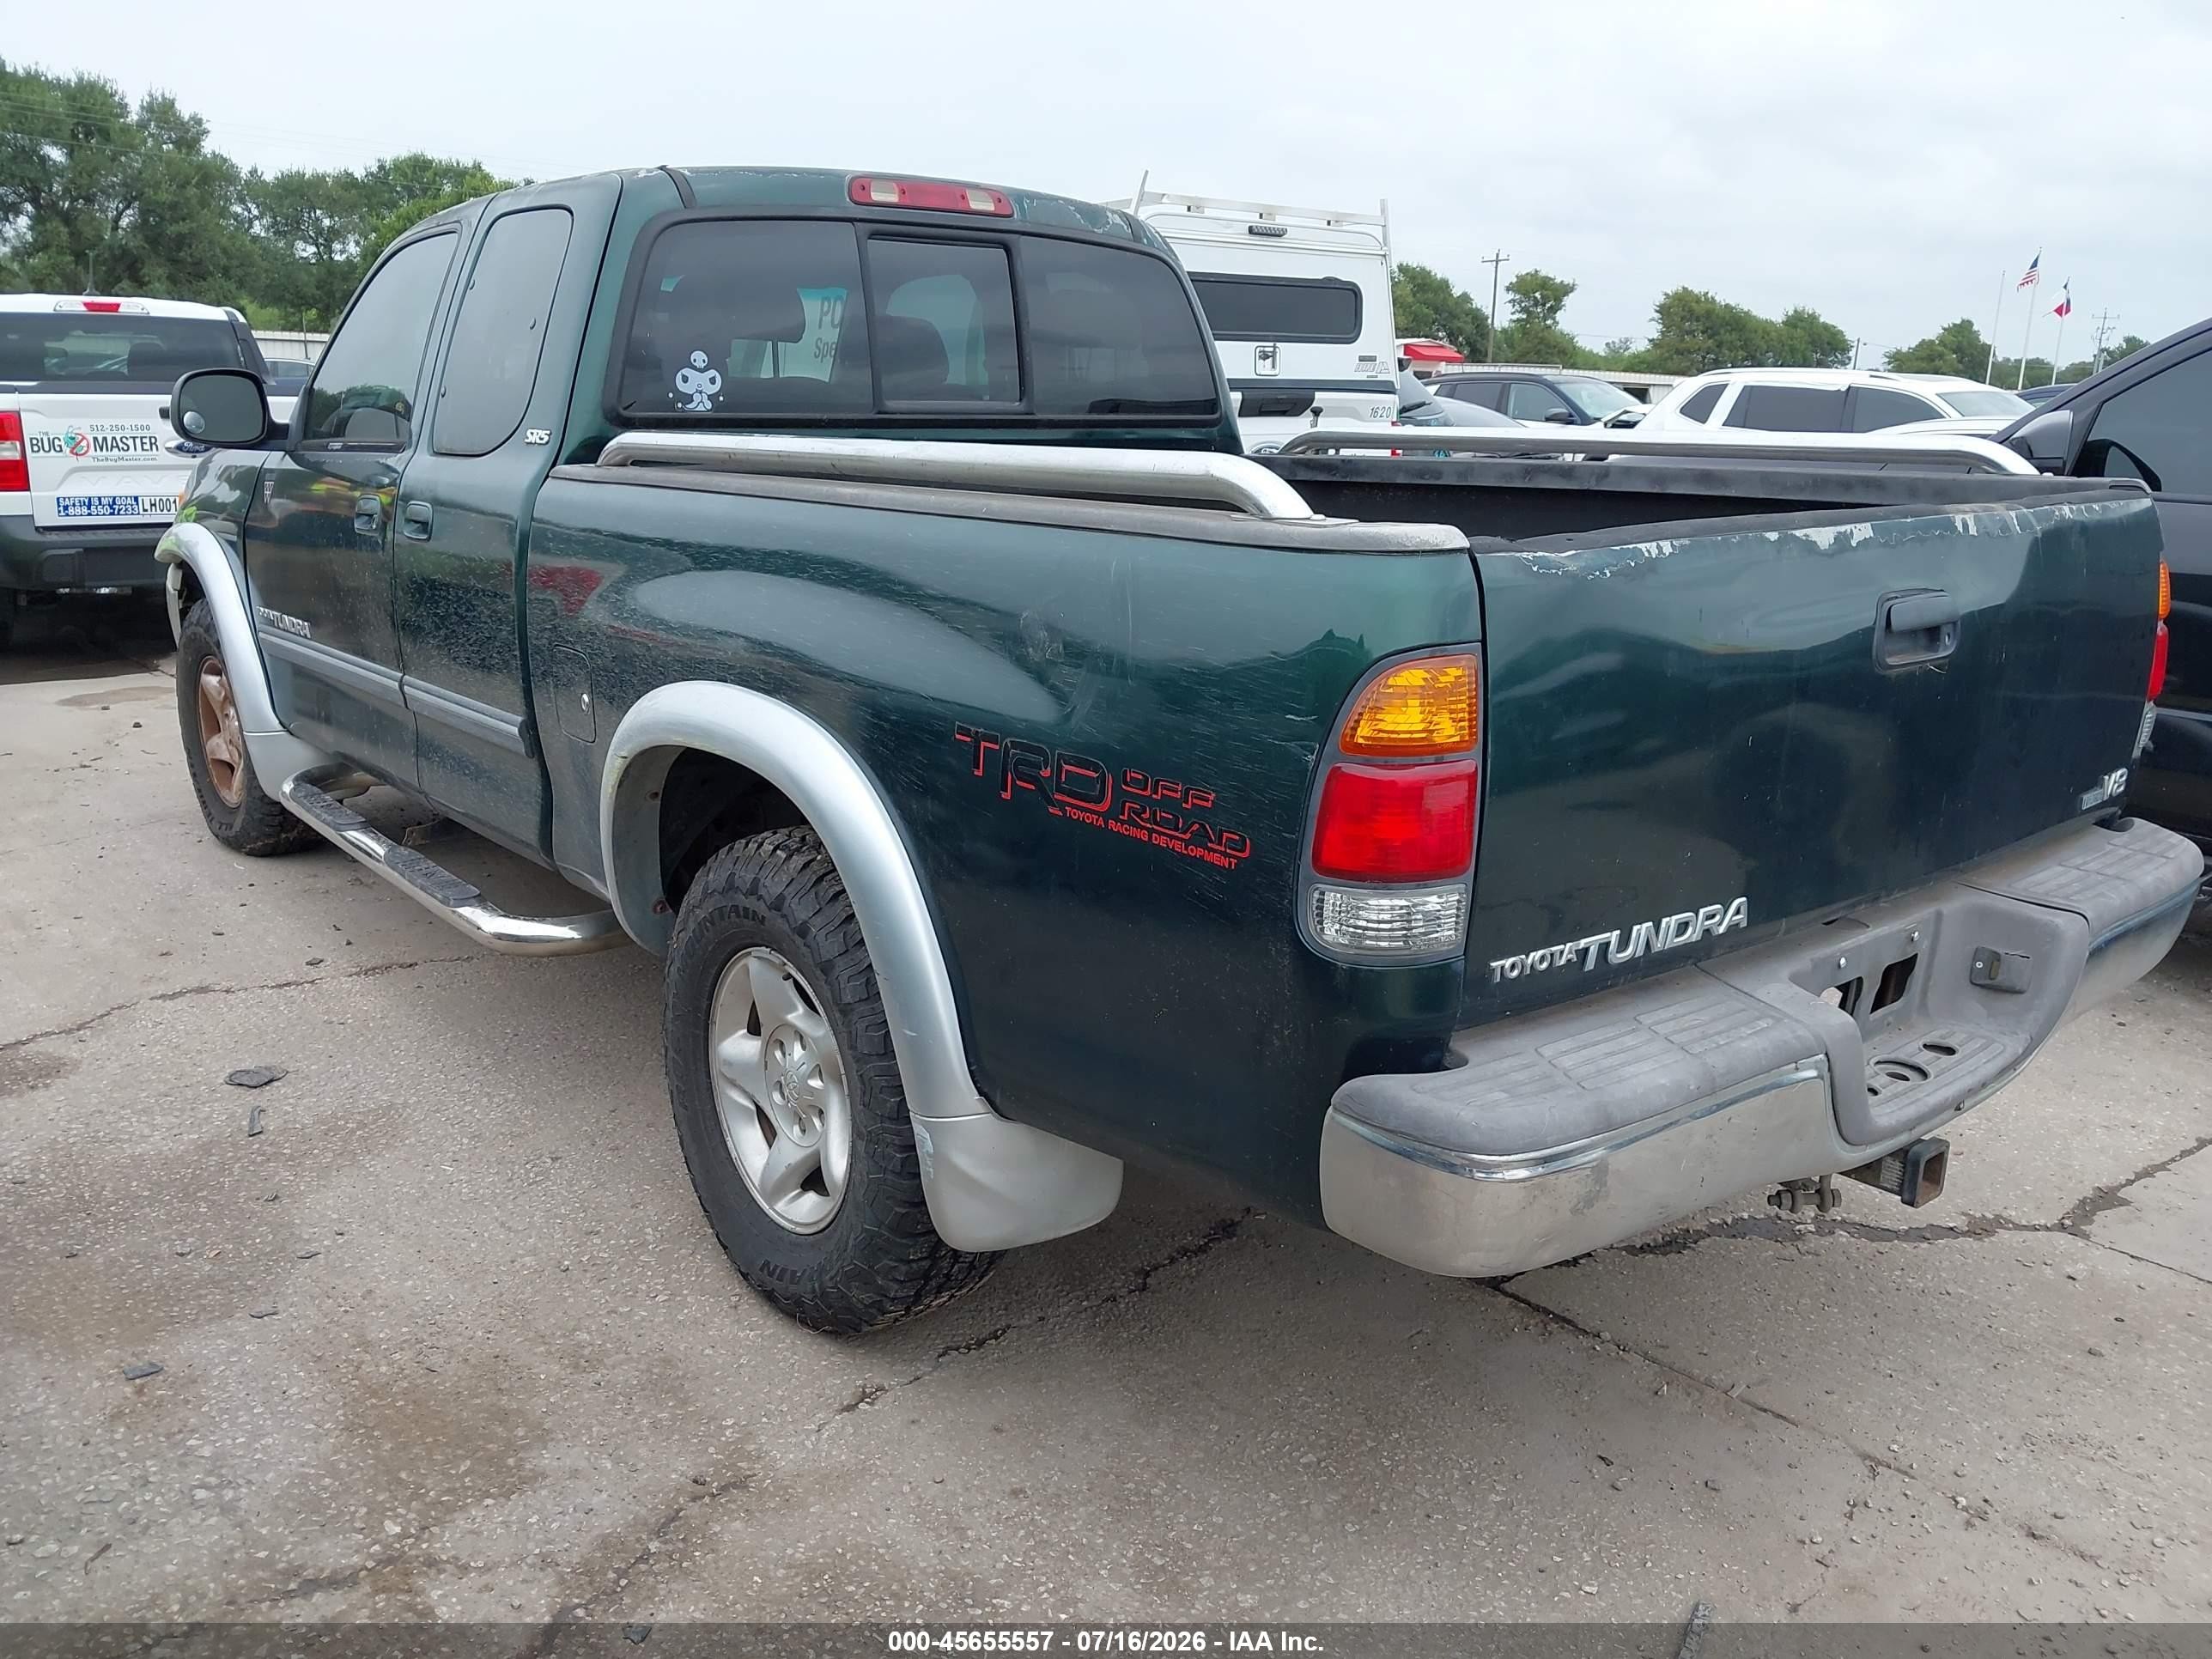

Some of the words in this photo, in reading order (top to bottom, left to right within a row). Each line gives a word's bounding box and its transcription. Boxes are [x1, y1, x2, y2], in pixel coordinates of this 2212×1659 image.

[1370, 406, 1391, 419] 1620
[29, 436, 64, 453] BUG
[92, 435, 159, 453] MASTER
[524, 428, 550, 444] SR5
[58, 496, 88, 506] SAFETY
[91, 496, 99, 505] IS
[100, 496, 113, 505] MY
[115, 496, 137, 505] GOAL
[58, 506, 139, 516] 1-888-550-7233
[272, 611, 312, 639] TUNDRA
[954, 721, 1113, 815] TRD
[1121, 769, 1216, 809] OFF
[2102, 768, 2128, 800] V8
[1064, 805, 1104, 829] TOYOTA
[1108, 819, 1149, 842] RACING
[1152, 832, 1237, 870] DEVELOPMENT
[1120, 799, 1250, 858] ROAD
[1489, 943, 1578, 983] TOYOTA
[1577, 896, 1748, 972] TUNDRA
